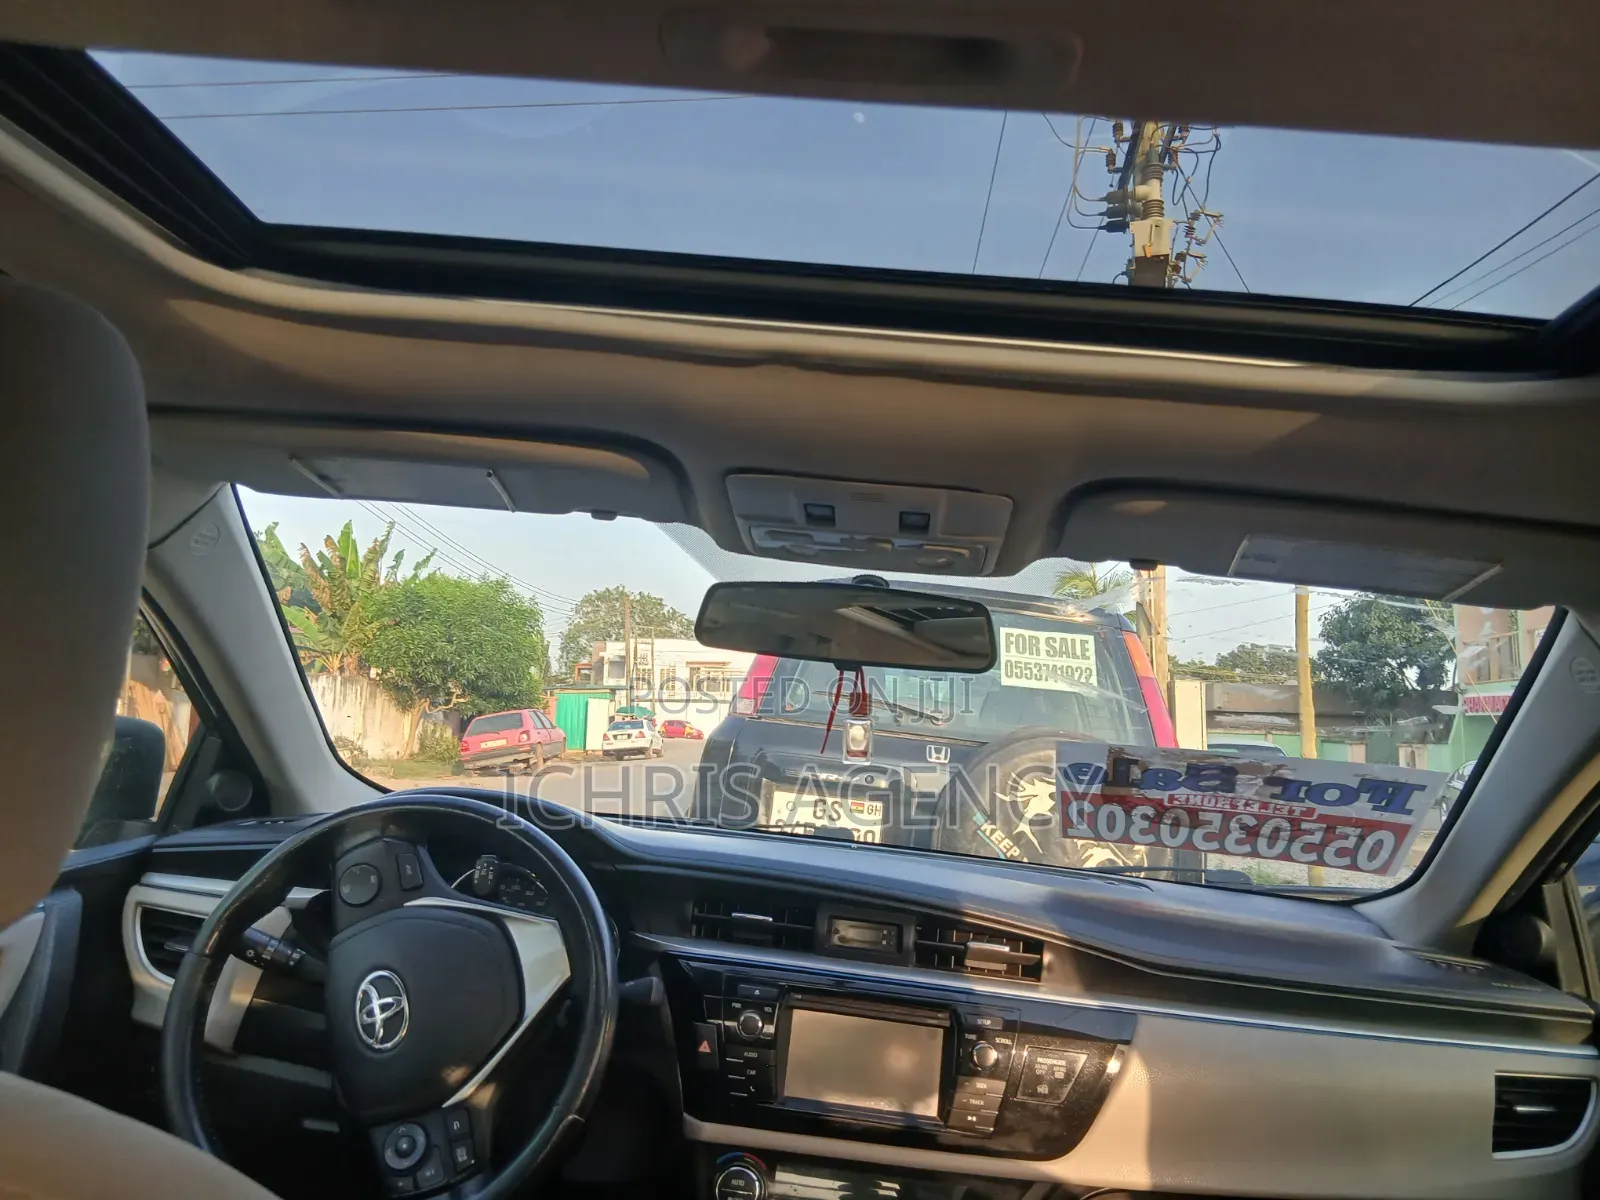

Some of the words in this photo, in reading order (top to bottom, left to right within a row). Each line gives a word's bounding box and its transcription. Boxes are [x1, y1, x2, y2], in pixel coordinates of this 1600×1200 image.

[1005, 632, 1041, 656] FOR
[1045, 636, 1091, 661] SALE
[813, 798, 843, 821] GS
[867, 804, 881, 817] GH
[980, 820, 1021, 859] KEEP
[731, 1178, 745, 1187] AUTO
